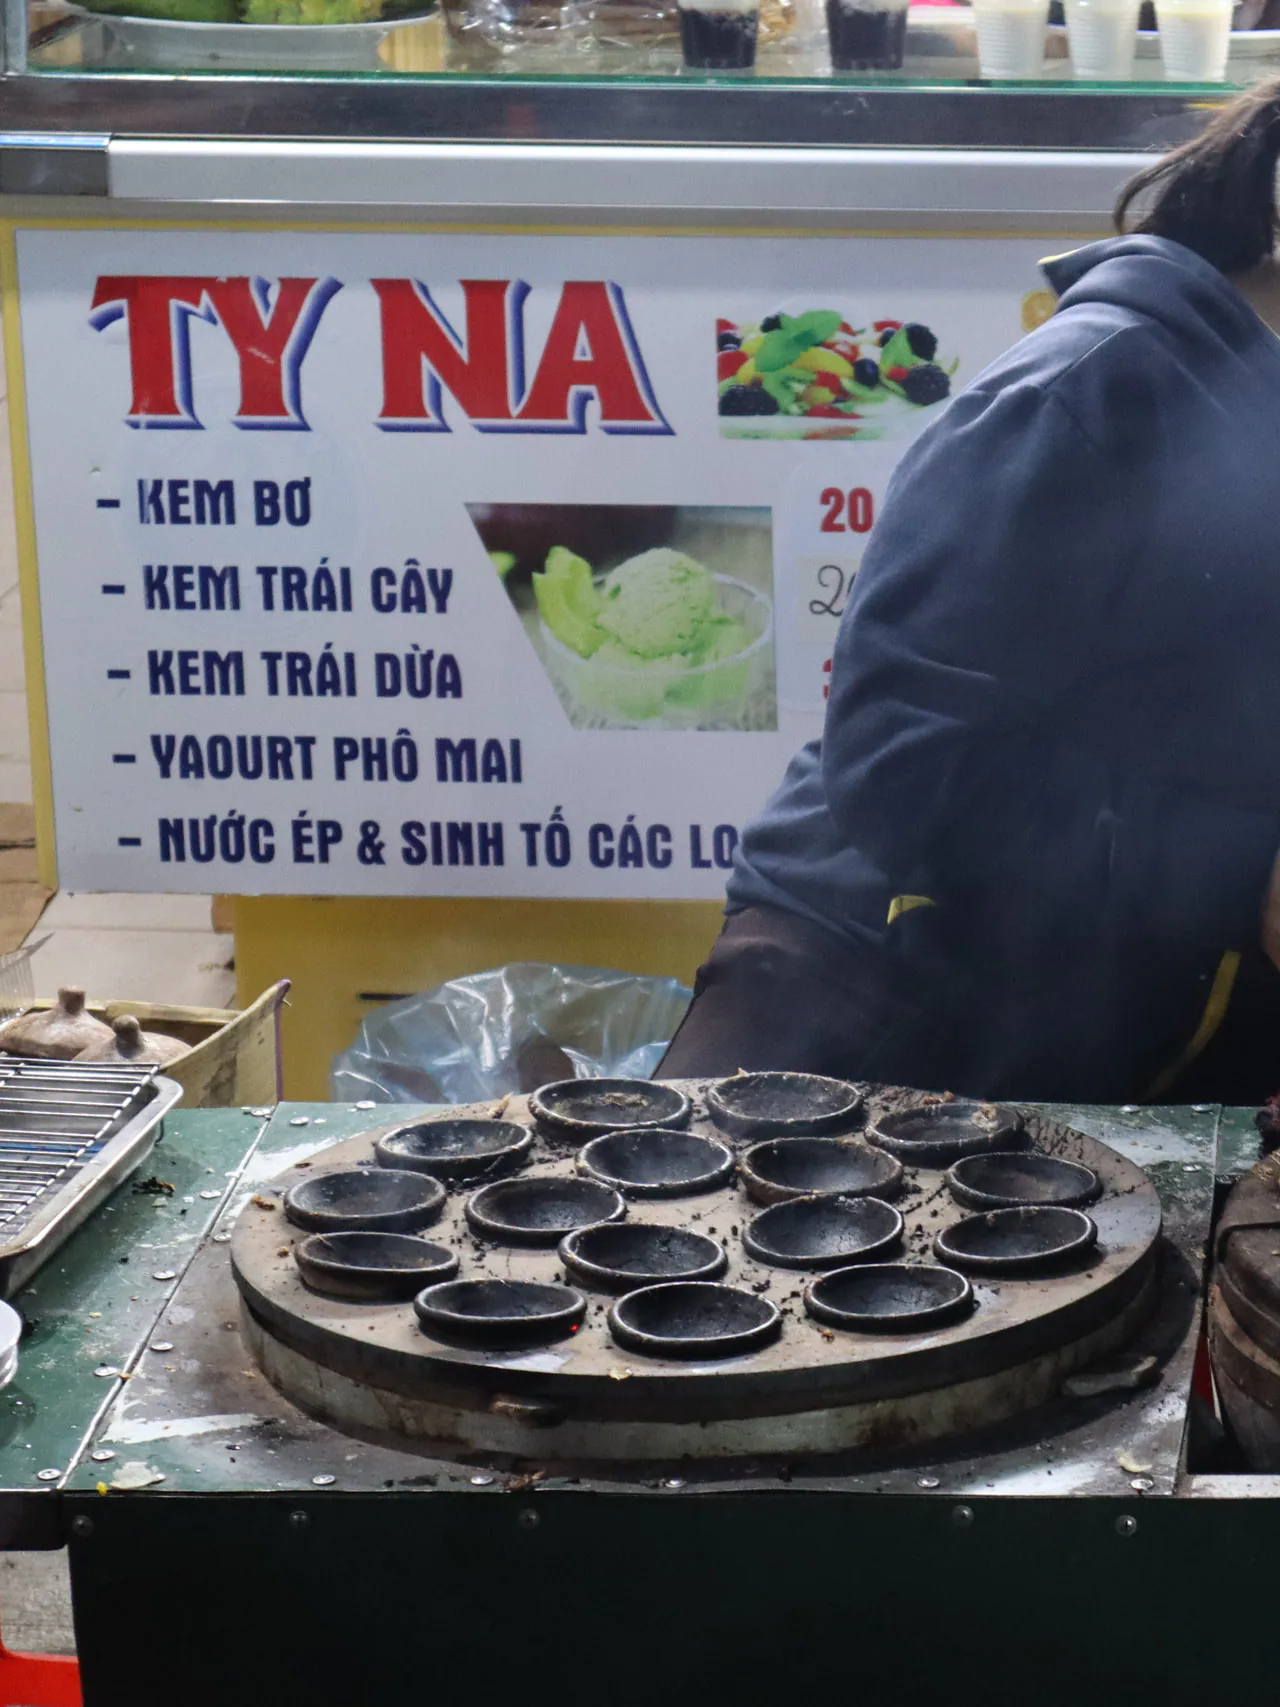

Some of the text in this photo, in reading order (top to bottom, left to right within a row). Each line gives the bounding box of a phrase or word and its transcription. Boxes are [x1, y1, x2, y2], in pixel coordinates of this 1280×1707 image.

[87, 275, 676, 436] TY NA
[138, 478, 236, 525] KEM
[254, 476, 311, 526] BƠ
[819, 487, 874, 533] 20
[143, 564, 241, 611] KEM
[256, 556, 353, 612] TRÁI
[370, 558, 453, 613] CÂY
[809, 564, 857, 617] 2
[148, 649, 246, 696] KEM
[260, 642, 357, 697] TRÁI
[374, 643, 463, 698] DỪA
[150, 734, 317, 781] YAOURT
[333, 728, 419, 782] PHÔ
[435, 737, 523, 784] MAI
[158, 809, 276, 864] NƯỚC
[291, 810, 344, 863] ÉP
[356, 819, 386, 865] &
[400, 820, 505, 866] SINH
[520, 805, 572, 868] TỐ
[588, 814, 674, 869] CÁC
